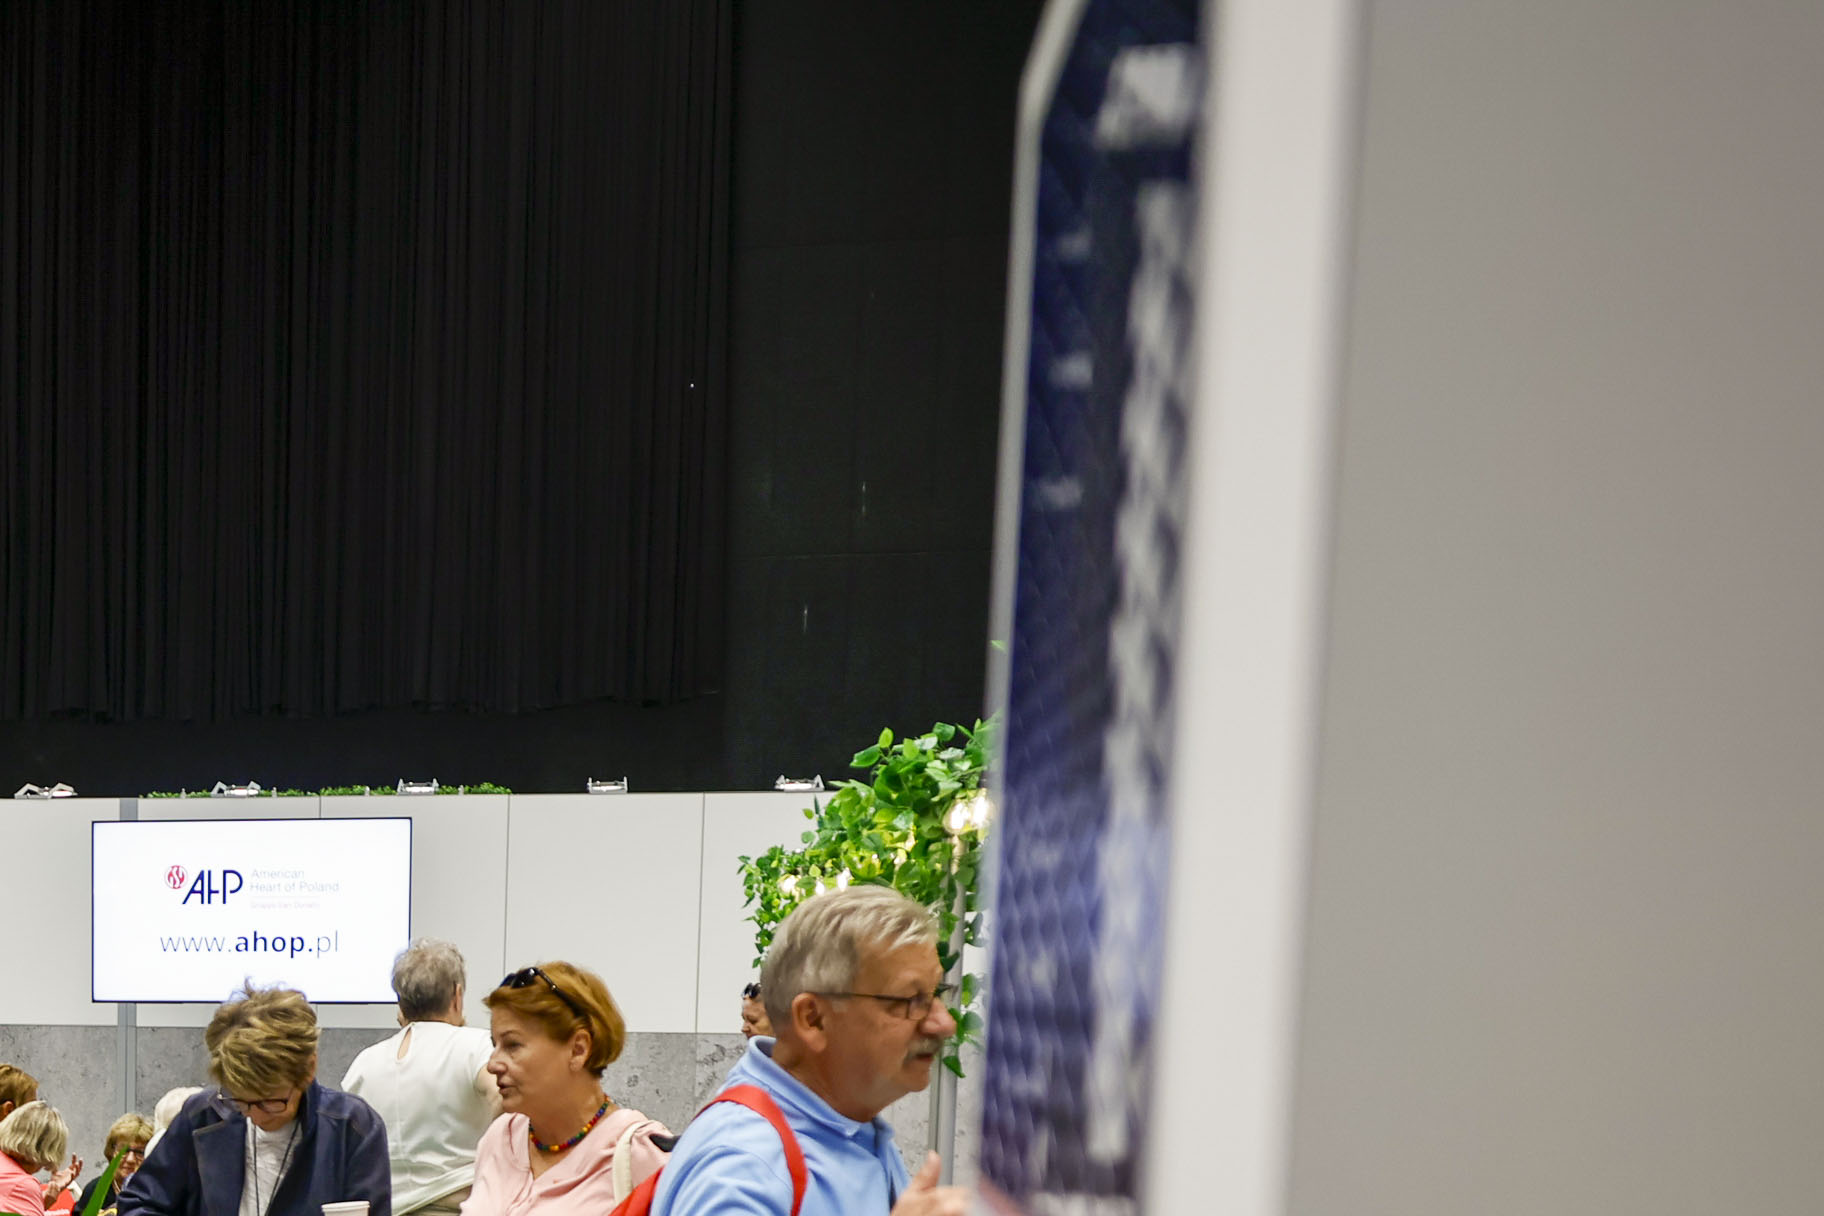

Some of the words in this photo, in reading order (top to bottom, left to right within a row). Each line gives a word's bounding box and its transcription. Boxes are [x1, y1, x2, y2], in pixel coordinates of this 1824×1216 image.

[250, 868, 305, 880] American
[249, 881, 281, 893] Heart
[284, 881, 296, 893] of
[299, 881, 340, 893] Poland
[160, 929, 339, 959] www.ahop.pl
